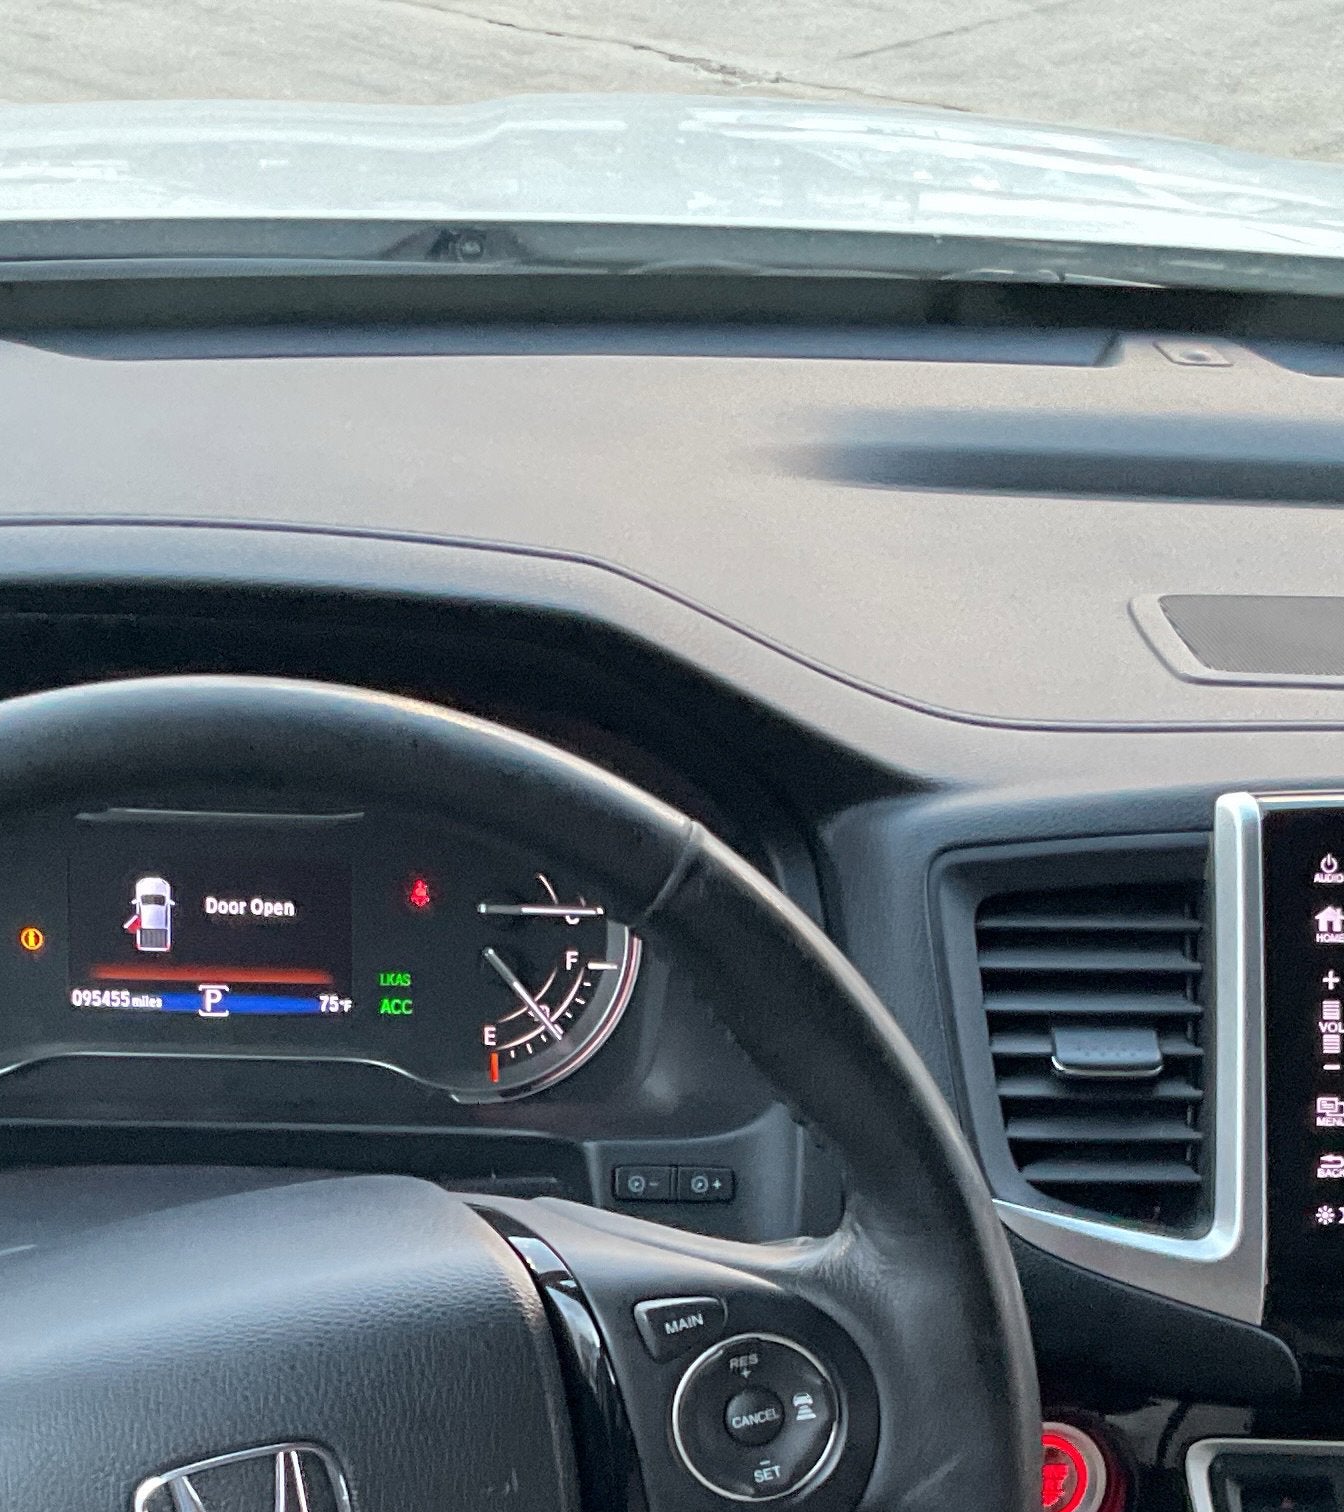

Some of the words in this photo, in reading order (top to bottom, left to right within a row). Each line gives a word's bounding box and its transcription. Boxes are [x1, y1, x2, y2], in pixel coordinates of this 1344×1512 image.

[1313, 872, 1344, 884] AUDIO
[205, 896, 246, 917] Door
[250, 897, 296, 919] Open
[564, 950, 579, 971] F
[379, 972, 412, 988] LKAS
[71, 988, 130, 1008] 095455
[131, 994, 163, 1009] miles
[205, 990, 223, 1012] P
[379, 998, 413, 1015] ACC
[483, 1025, 497, 1046] E
[664, 1312, 704, 1335] MAIN
[729, 1353, 759, 1370] RES
[731, 1407, 779, 1429] CANCEL
[753, 1464, 781, 1483] SET
